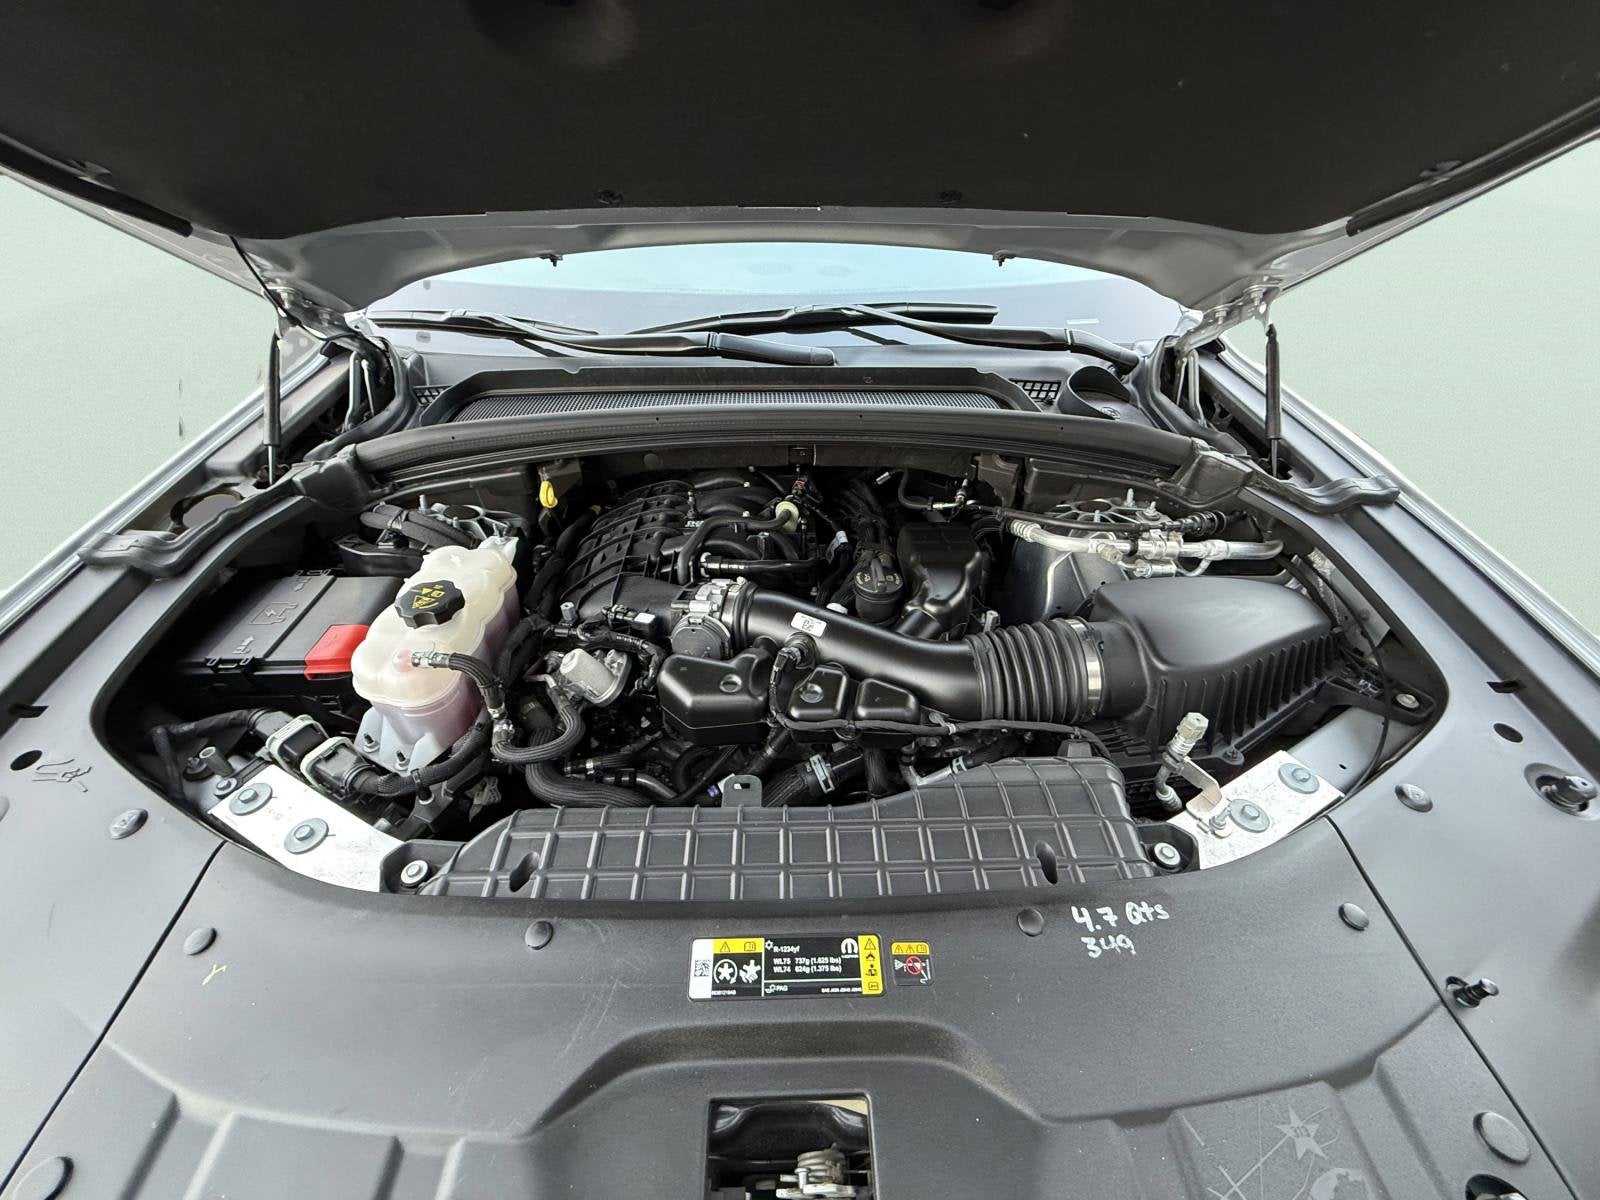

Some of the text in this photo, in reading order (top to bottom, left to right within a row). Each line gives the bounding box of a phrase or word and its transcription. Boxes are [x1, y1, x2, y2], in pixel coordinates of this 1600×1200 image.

[1070, 905, 1118, 932] 4.7
[773, 945, 800, 954] R-1234yf
[1080, 933, 1137, 958] 349
[773, 957, 791, 965] WL75
[794, 957, 810, 966] 737g
[773, 965, 791, 973] WL74
